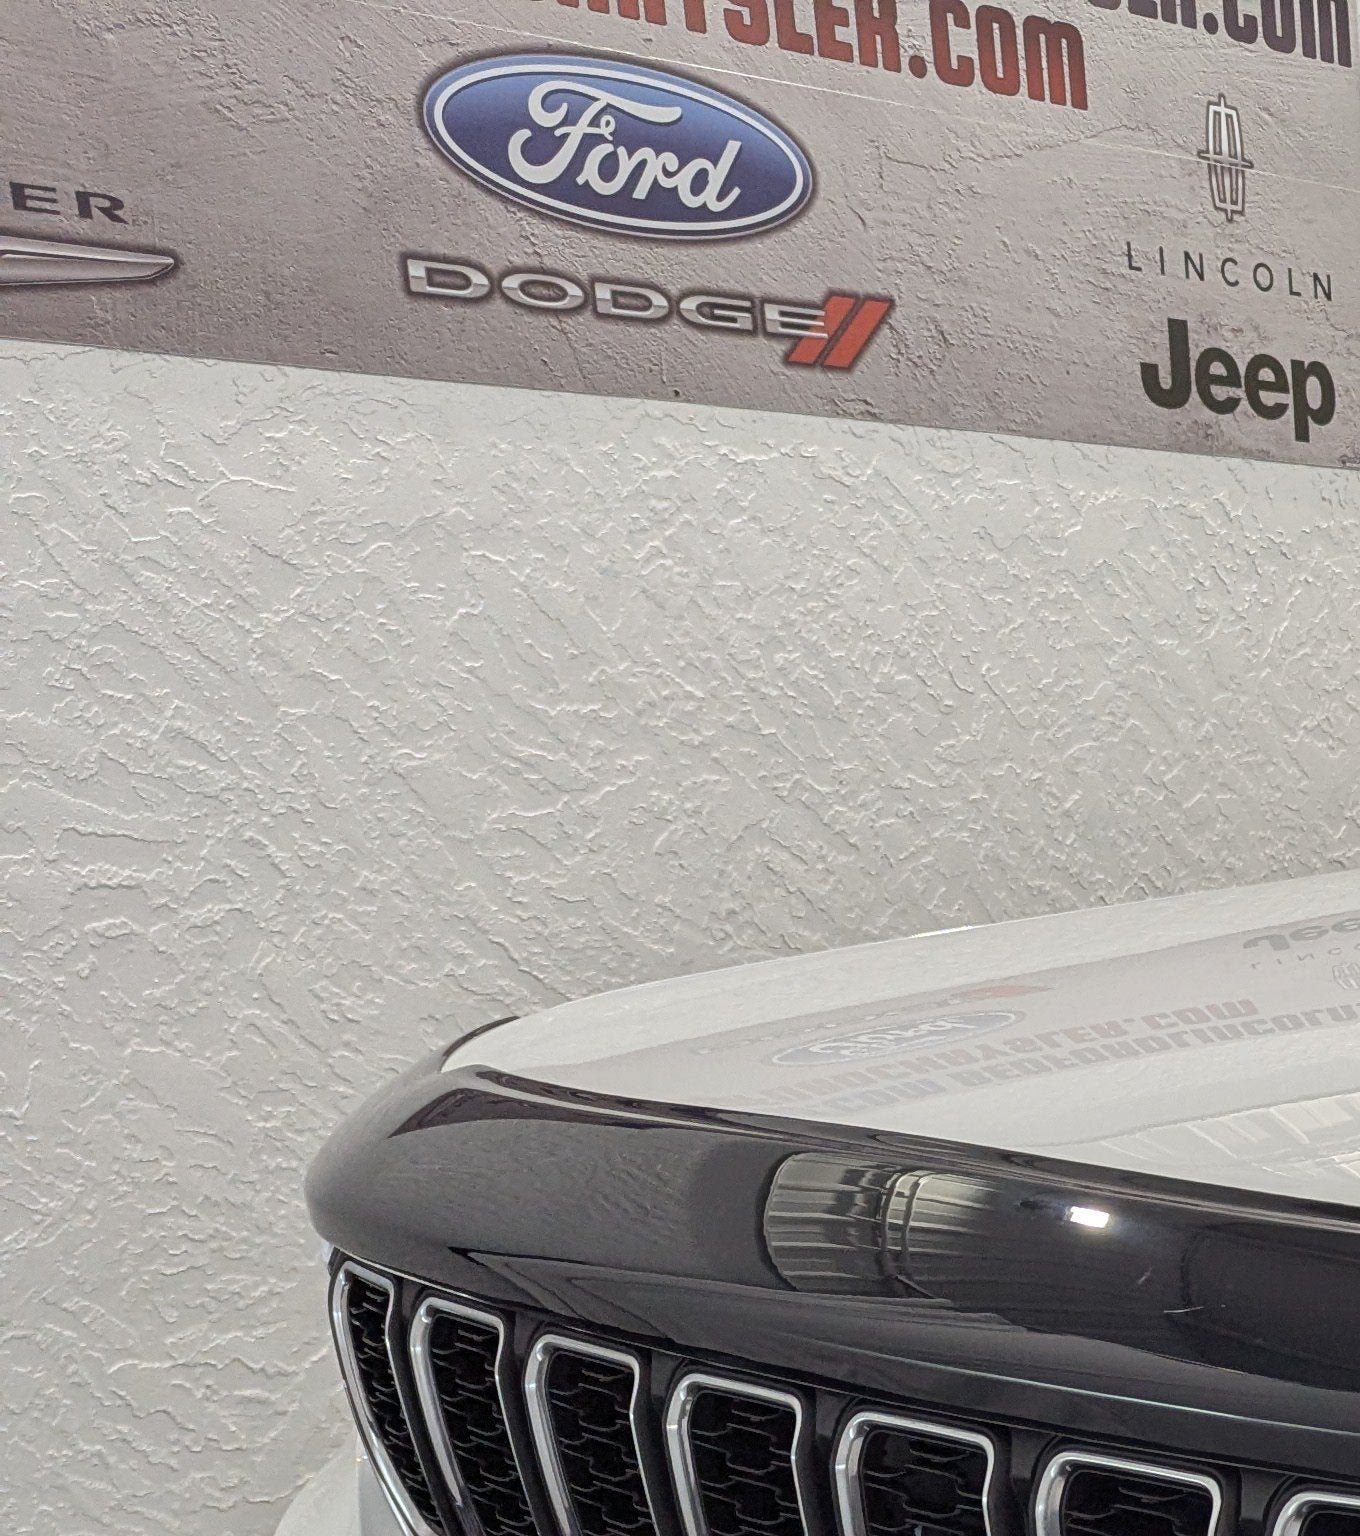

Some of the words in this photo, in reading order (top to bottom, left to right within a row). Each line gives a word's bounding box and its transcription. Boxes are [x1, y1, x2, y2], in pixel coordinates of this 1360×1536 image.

[507, 80, 742, 213] Ford
[407, 259, 829, 339] DODGE
[1126, 241, 1333, 302] LINCOLN
[1139, 317, 1336, 443] Jeep
